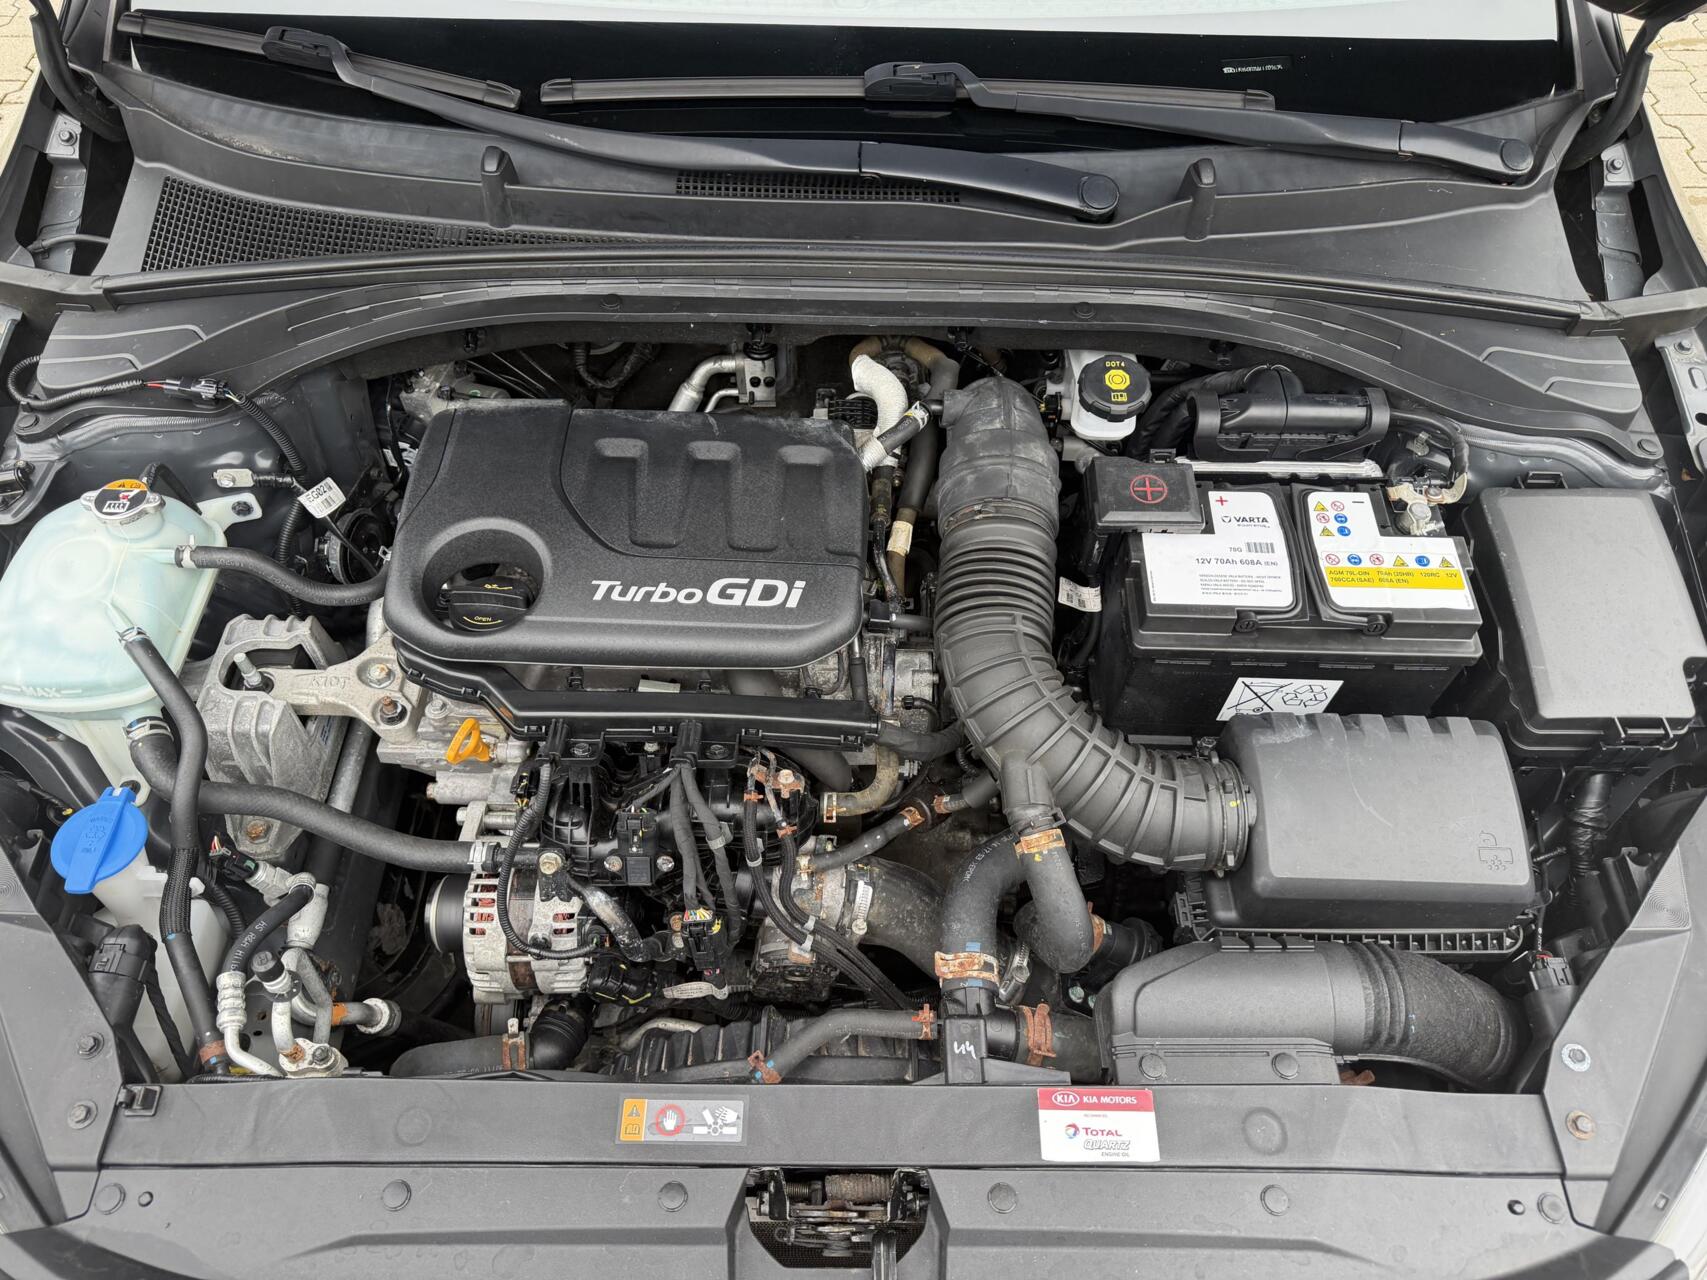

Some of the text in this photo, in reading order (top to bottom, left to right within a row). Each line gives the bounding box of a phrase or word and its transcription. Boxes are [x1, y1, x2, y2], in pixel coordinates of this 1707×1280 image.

[20, 685, 61, 698] MAX
[1056, 1095, 1075, 1103] KIA
[1083, 1095, 1137, 1104] KIA MOTORS
[1083, 1140, 1130, 1151] QUARTZ
